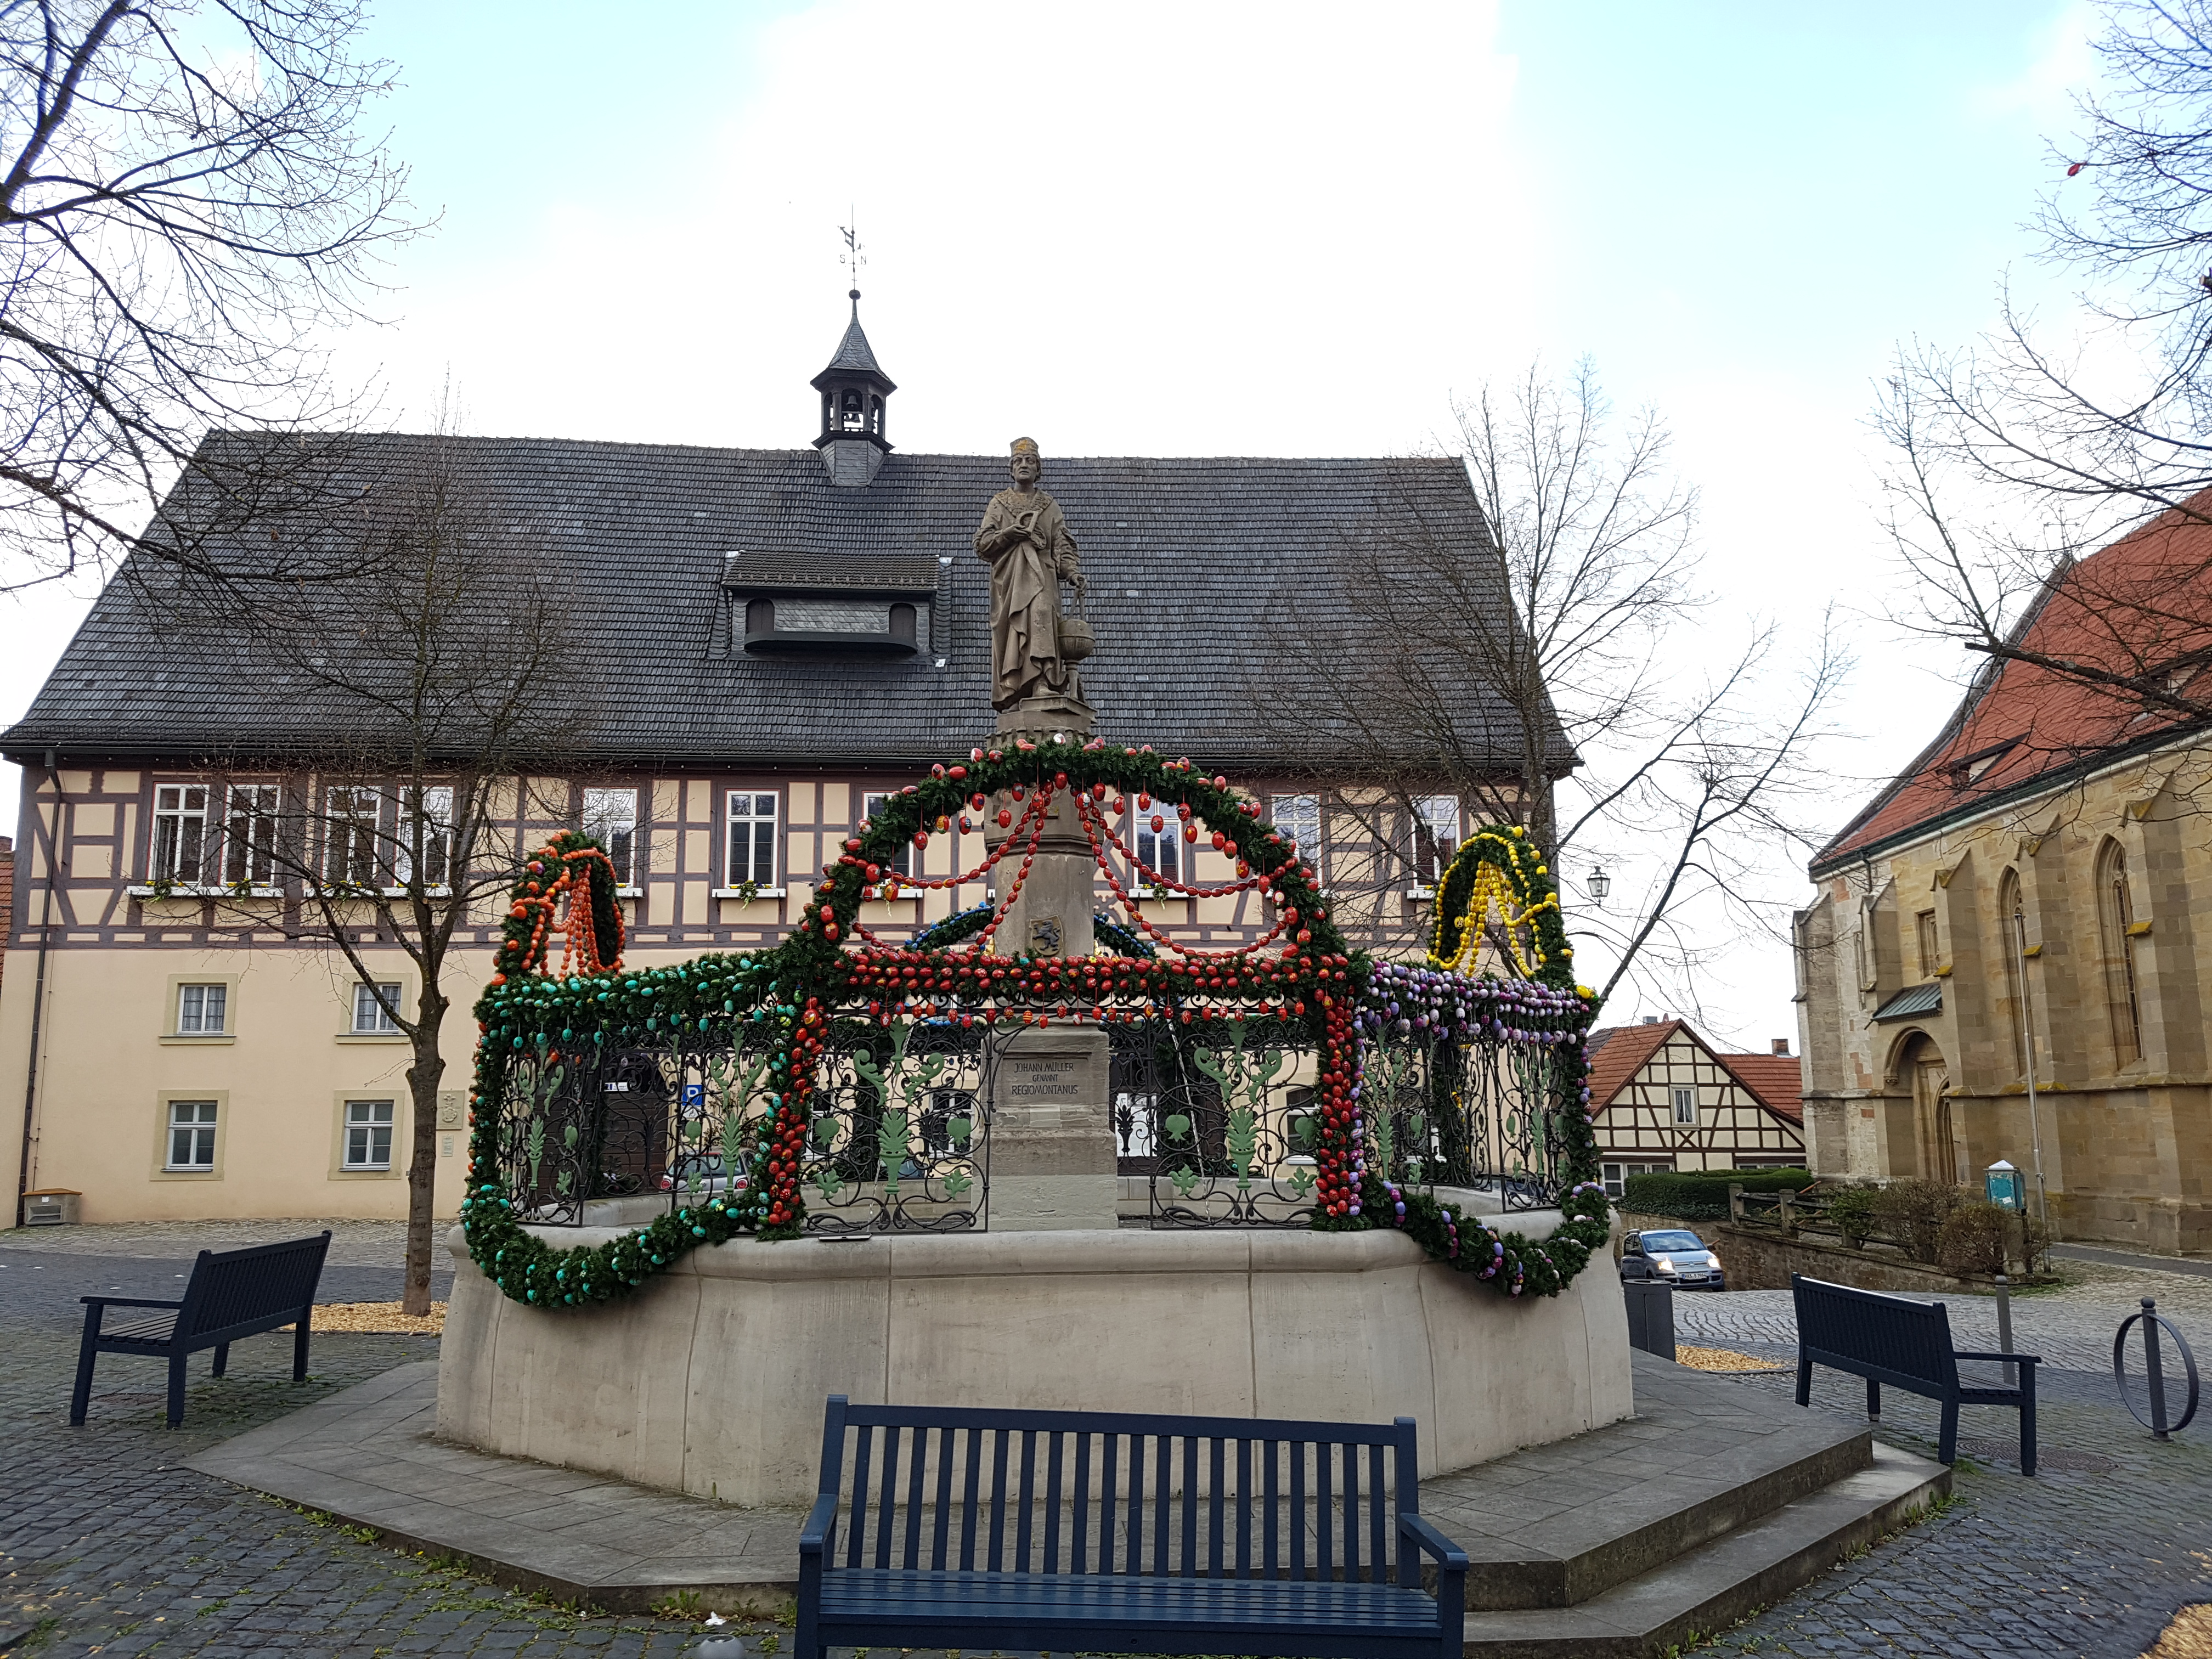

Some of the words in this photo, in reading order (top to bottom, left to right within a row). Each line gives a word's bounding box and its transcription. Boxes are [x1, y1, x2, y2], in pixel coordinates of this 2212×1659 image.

[1014, 1063, 1042, 1073] JOHANN
[1044, 1062, 1075, 1072] MÜLLER
[1032, 1074, 1058, 1082] GENANNT
[687, 1087, 699, 1102] P
[1012, 1085, 1079, 1095] REGIOMONTANUS
